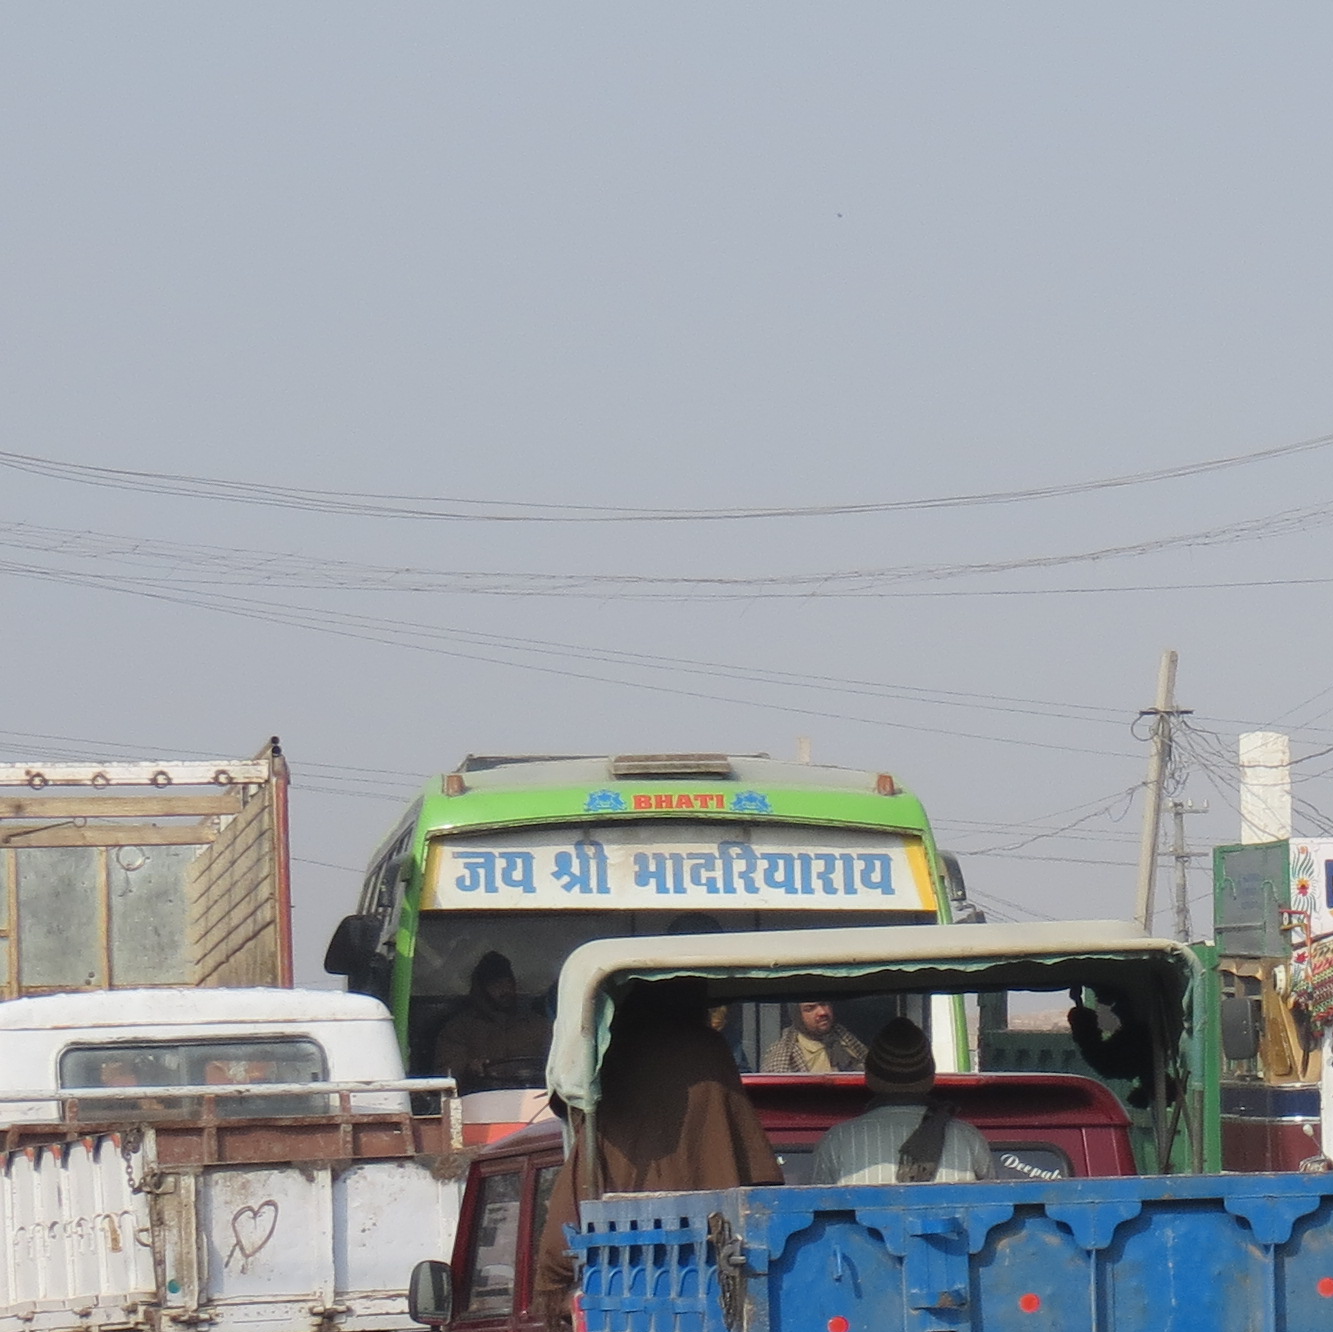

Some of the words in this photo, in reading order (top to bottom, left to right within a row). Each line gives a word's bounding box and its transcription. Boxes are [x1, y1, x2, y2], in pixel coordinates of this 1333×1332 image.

[633, 793, 726, 811] BHATI
[452, 850, 537, 895] जय
[549, 838, 612, 896] श्री
